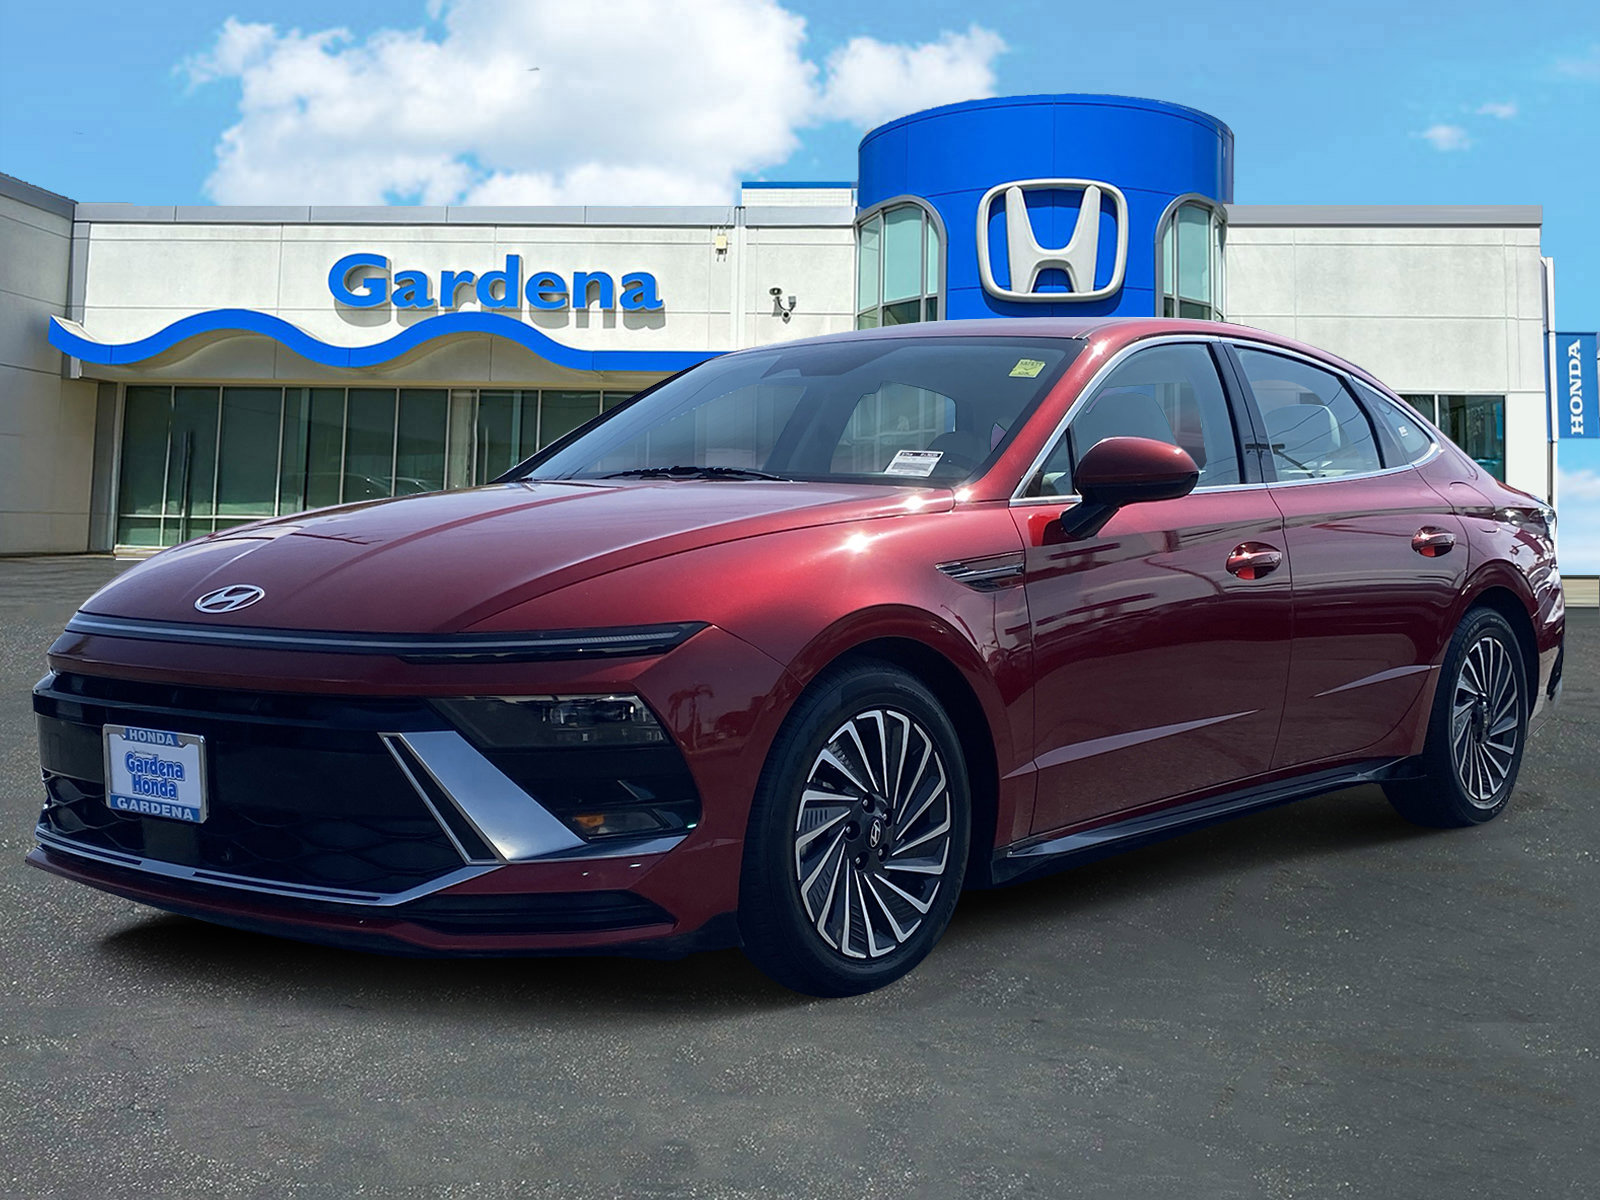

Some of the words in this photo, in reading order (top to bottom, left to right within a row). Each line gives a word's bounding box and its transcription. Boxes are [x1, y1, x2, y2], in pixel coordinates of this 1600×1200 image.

[328, 252, 664, 311] Gardena
[1568, 339, 1584, 435] HONDA
[129, 730, 174, 745] HONDA
[125, 751, 185, 781] Gardena
[131, 774, 178, 800] Honda
[116, 797, 194, 821] GARDENA
